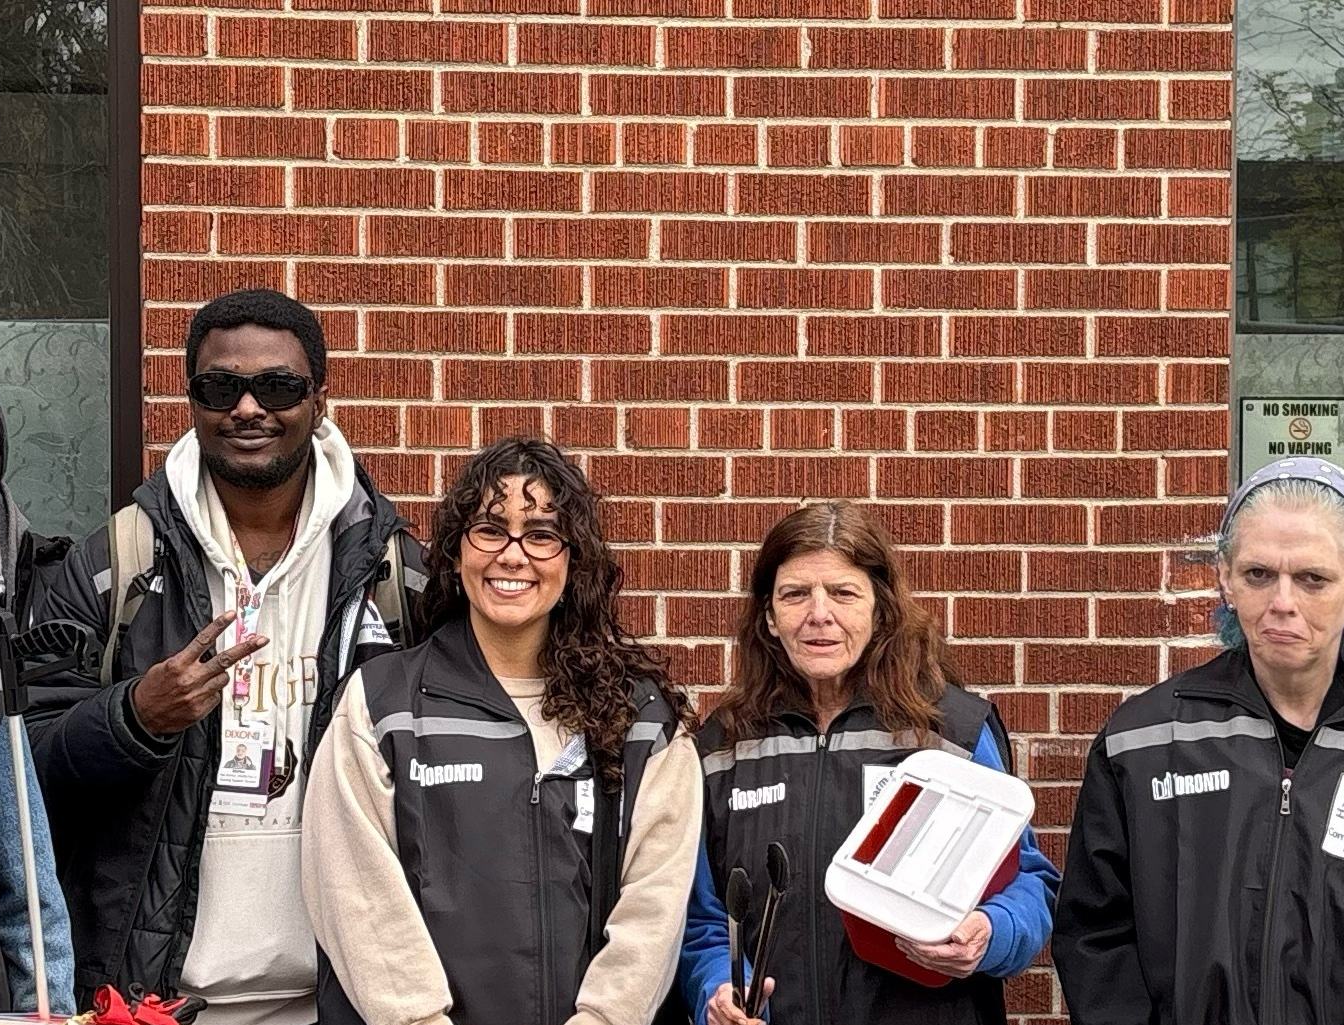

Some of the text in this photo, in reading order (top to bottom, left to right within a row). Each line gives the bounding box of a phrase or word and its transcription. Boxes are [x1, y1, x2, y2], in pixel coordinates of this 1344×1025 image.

[1263, 403, 1339, 416] NO SMOKING
[1268, 442, 1332, 455] NO VAPING
[417, 763, 483, 787] TORONTO
[731, 782, 786, 811] TORONTO
